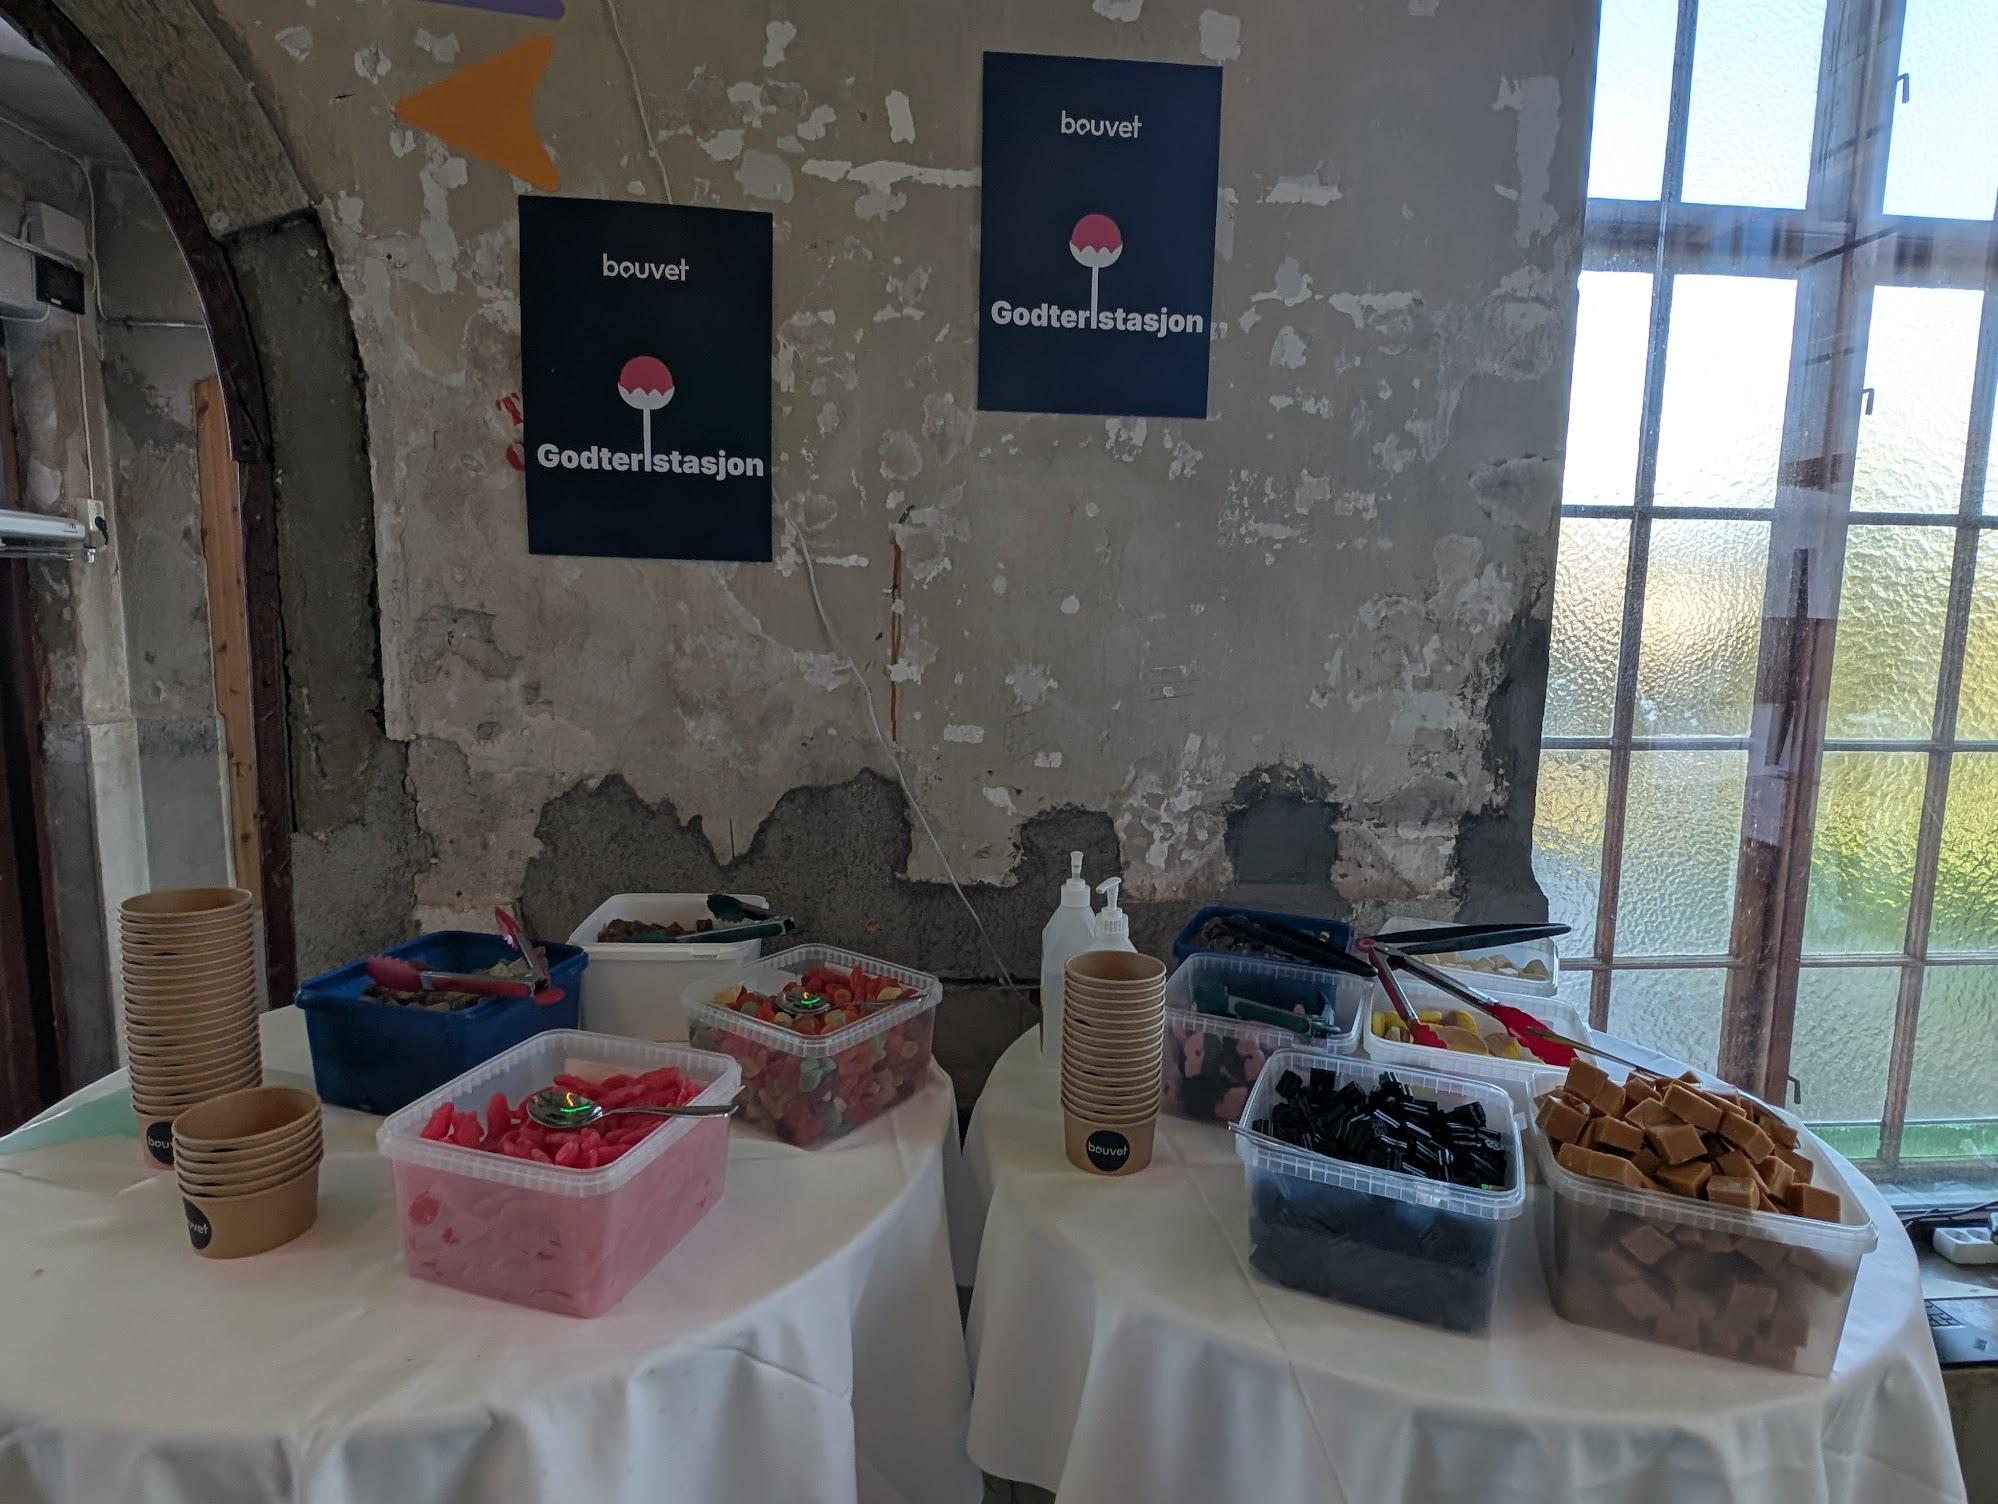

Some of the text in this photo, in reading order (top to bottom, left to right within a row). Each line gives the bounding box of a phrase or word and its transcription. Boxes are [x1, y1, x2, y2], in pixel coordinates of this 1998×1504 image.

[1060, 110, 1143, 138] bouvet
[602, 252, 690, 281] bouvet
[1088, 1140, 1128, 1157] bouvet
